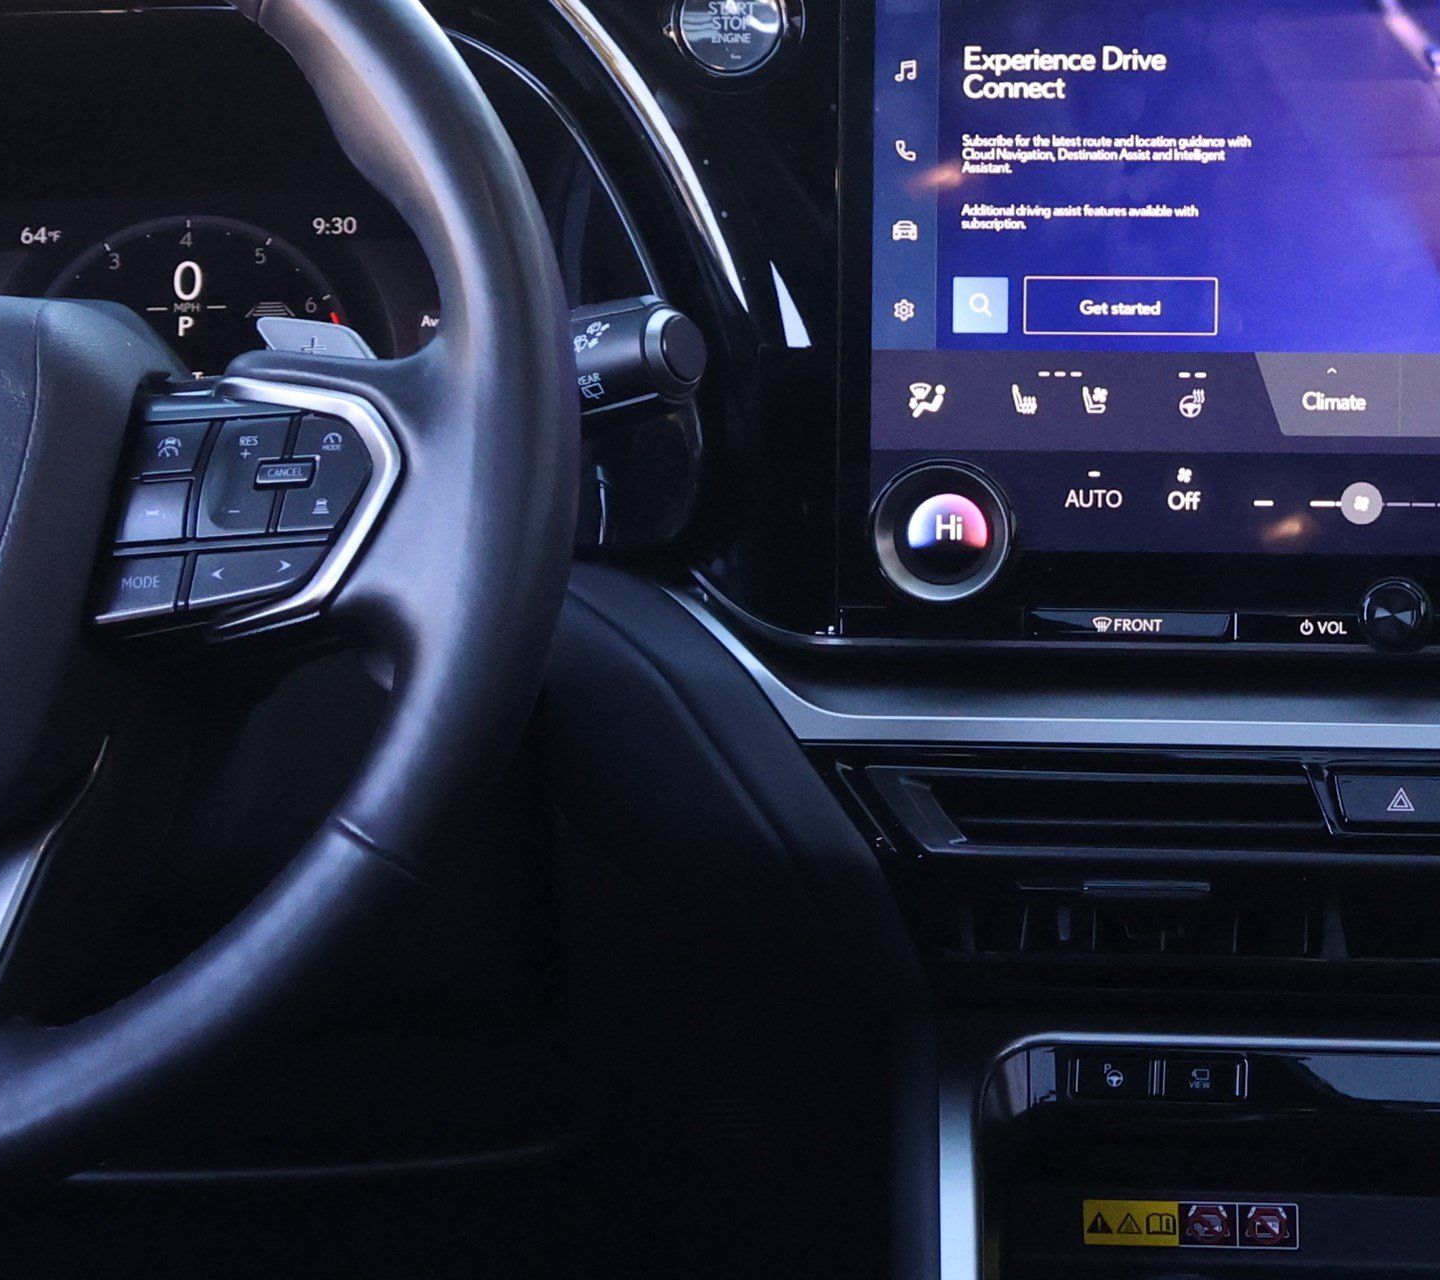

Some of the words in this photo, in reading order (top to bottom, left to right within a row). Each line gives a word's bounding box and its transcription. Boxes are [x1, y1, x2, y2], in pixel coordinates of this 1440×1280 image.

[708, 2, 755, 15] START
[711, 33, 751, 43] ENGINE
[963, 46, 1096, 74] Experience
[1102, 46, 1167, 72] Drive
[963, 74, 1066, 100] Connect
[962, 134, 1013, 148] Subscribe
[1015, 134, 1030, 148] for
[1033, 135, 1050, 148] the
[1052, 135, 1081, 148] latest
[1083, 136, 1112, 148] route
[1113, 135, 1134, 148] and
[1135, 135, 1176, 148] location
[1178, 134, 1226, 150] guidance
[1228, 135, 1252, 148] with
[962, 148, 995, 161] Cloud
[996, 148, 1055, 162] Navigation,
[1058, 148, 1118, 161] Destination
[1119, 148, 1150, 161] Assist
[1152, 149, 1173, 161] and
[1174, 149, 1226, 163] Intelligent
[962, 161, 1013, 174] Assistant.
[961, 204, 1015, 217] Additional
[1016, 204, 1051, 219] driving
[1053, 205, 1081, 217] assist
[1083, 205, 1128, 217] features
[1128, 205, 1172, 218] available
[1174, 205, 1199, 218] with
[312, 216, 357, 236] 9:30
[961, 218, 1027, 231] subscription.
[179, 231, 193, 248] 4
[109, 252, 121, 270] 3
[255, 248, 267, 265] 5
[173, 260, 203, 302] 0
[173, 302, 202, 314] MPH
[304, 296, 317, 314] 6
[1079, 301, 1108, 316] Get
[1110, 301, 1162, 316] started
[177, 316, 195, 337] P
[1302, 392, 1367, 412] Climate
[239, 436, 258, 446] RES
[267, 467, 304, 477] CANCEL
[1065, 489, 1122, 509] AUTO
[1167, 490, 1201, 511] Off
[935, 515, 963, 541] Hi
[121, 574, 161, 590] MODE
[1114, 618, 1163, 633] FRONT
[1318, 620, 1347, 635] VOL
